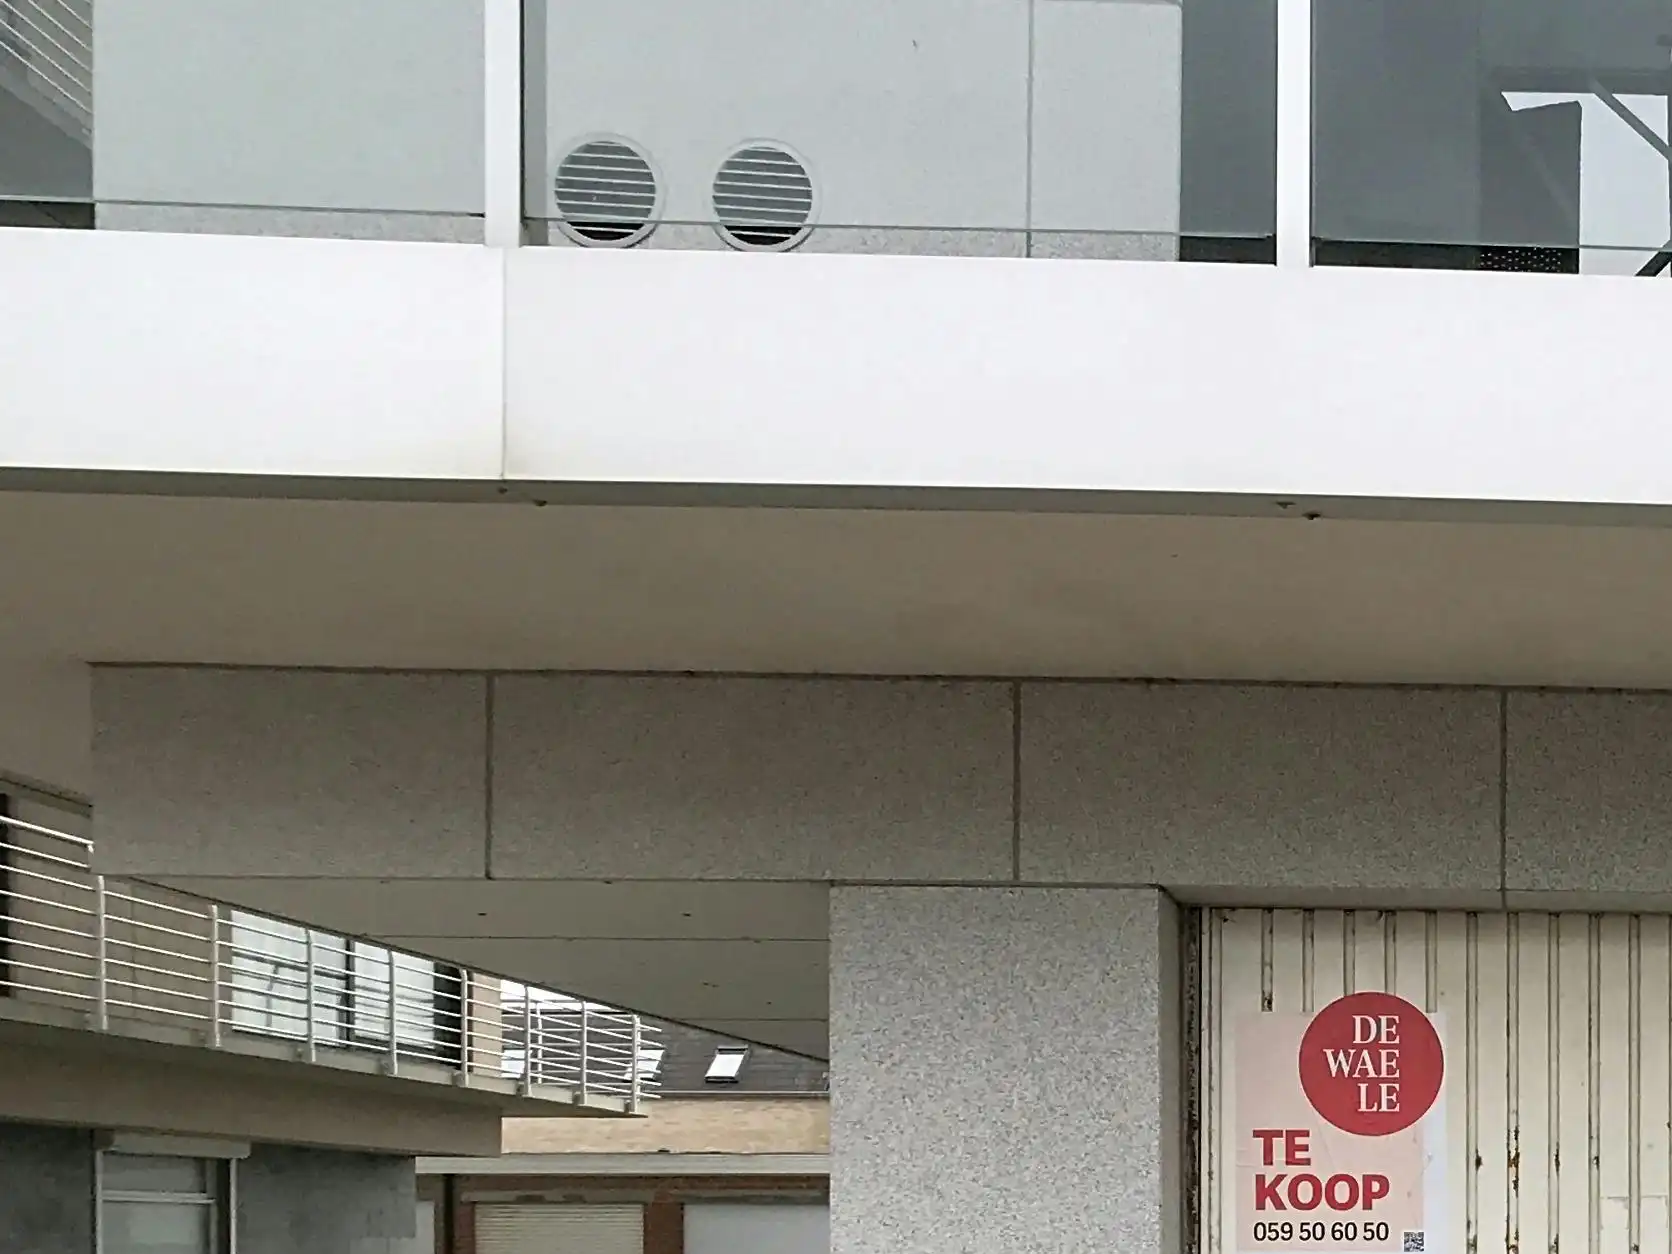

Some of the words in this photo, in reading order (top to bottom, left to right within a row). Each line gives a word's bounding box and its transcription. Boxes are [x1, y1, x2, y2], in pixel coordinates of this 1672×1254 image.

[1352, 1015, 1400, 1044] DE
[1323, 1049, 1400, 1078] WAE
[1357, 1083, 1400, 1112] LE
[1253, 1129, 1311, 1166] TE
[1255, 1173, 1390, 1211] KOOP
[1253, 1221, 1293, 1242] 059
[1299, 1221, 1326, 1242] 50
[1331, 1221, 1358, 1242] 60
[1362, 1221, 1390, 1242] 50
